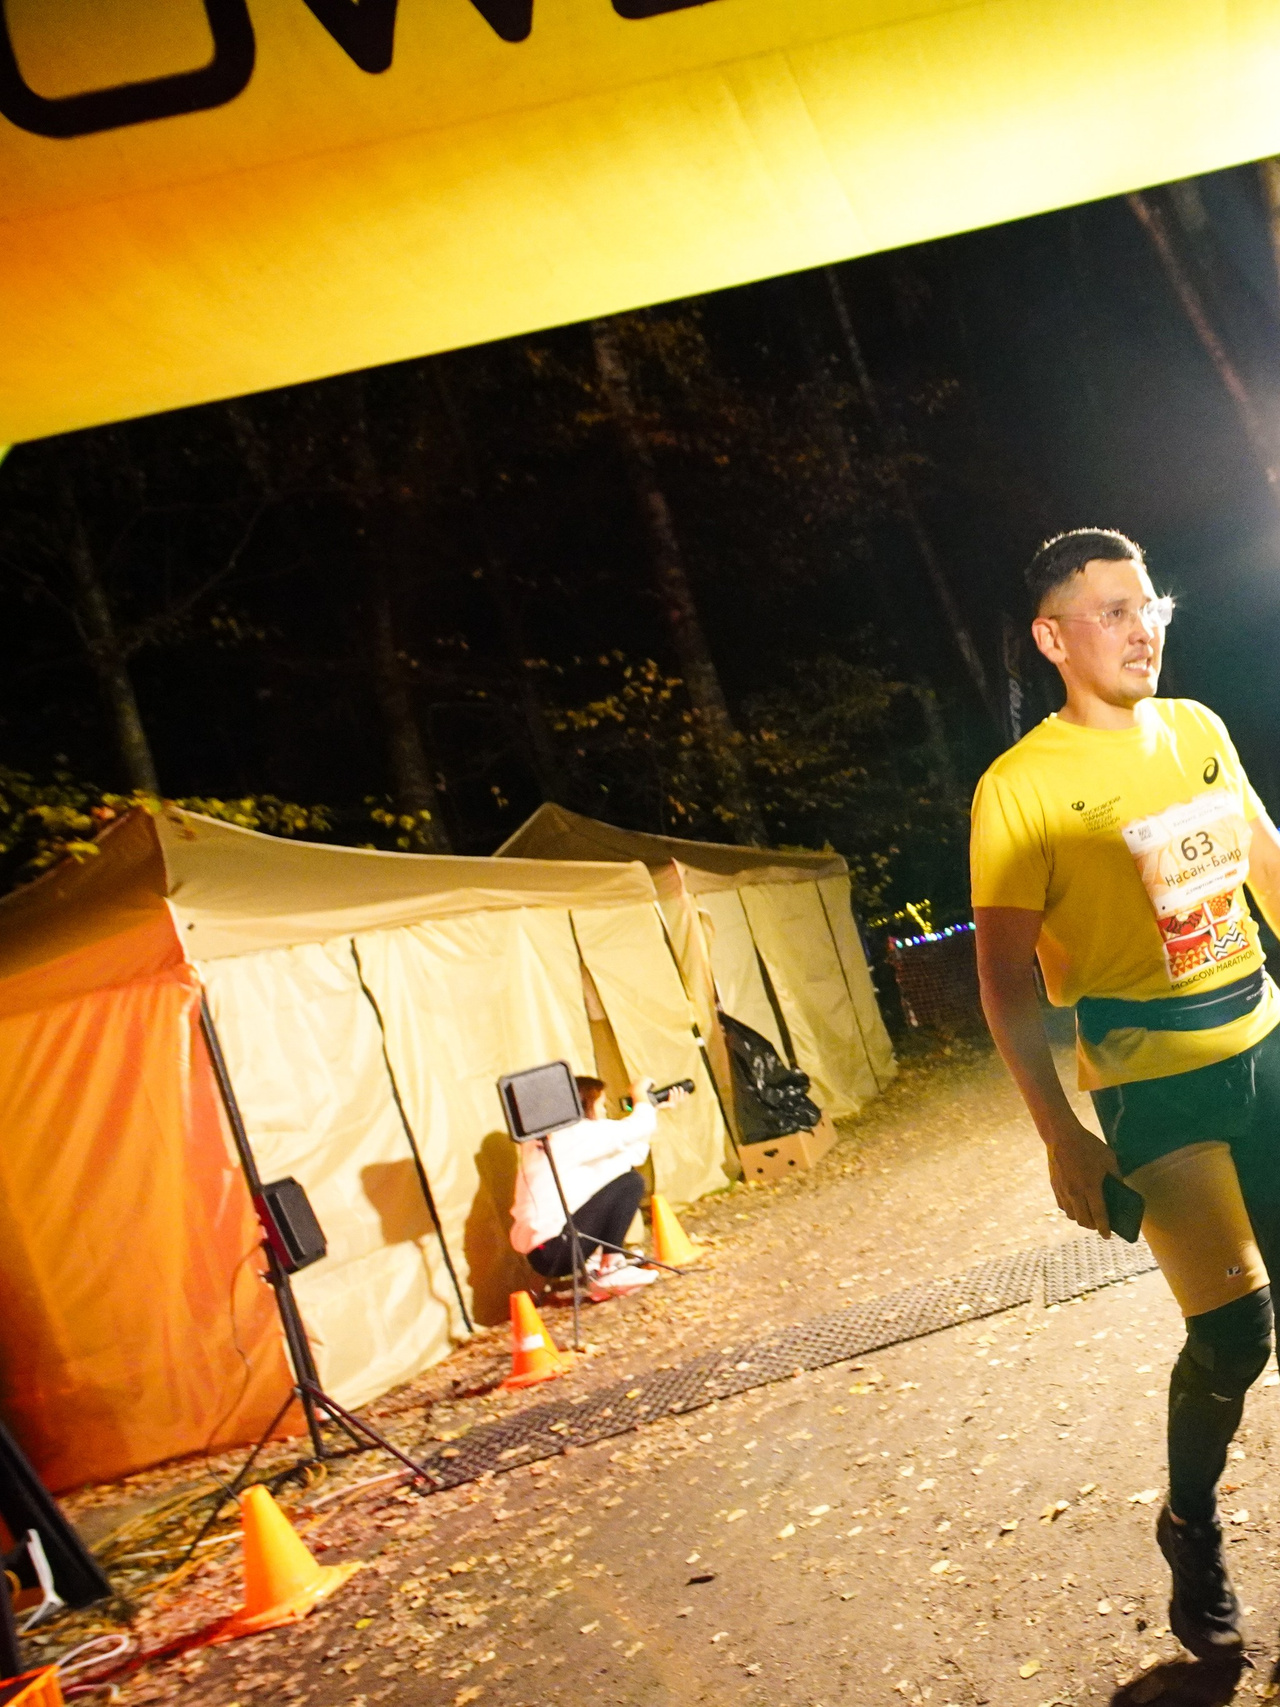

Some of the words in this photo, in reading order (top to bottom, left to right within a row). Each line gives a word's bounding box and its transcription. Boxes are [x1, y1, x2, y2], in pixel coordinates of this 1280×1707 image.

[1181, 831, 1214, 861] 63
[1165, 848, 1242, 888] Насан-Баир
[1171, 968, 1215, 991] MOSCOW
[1216, 949, 1255, 972] MARATHON
